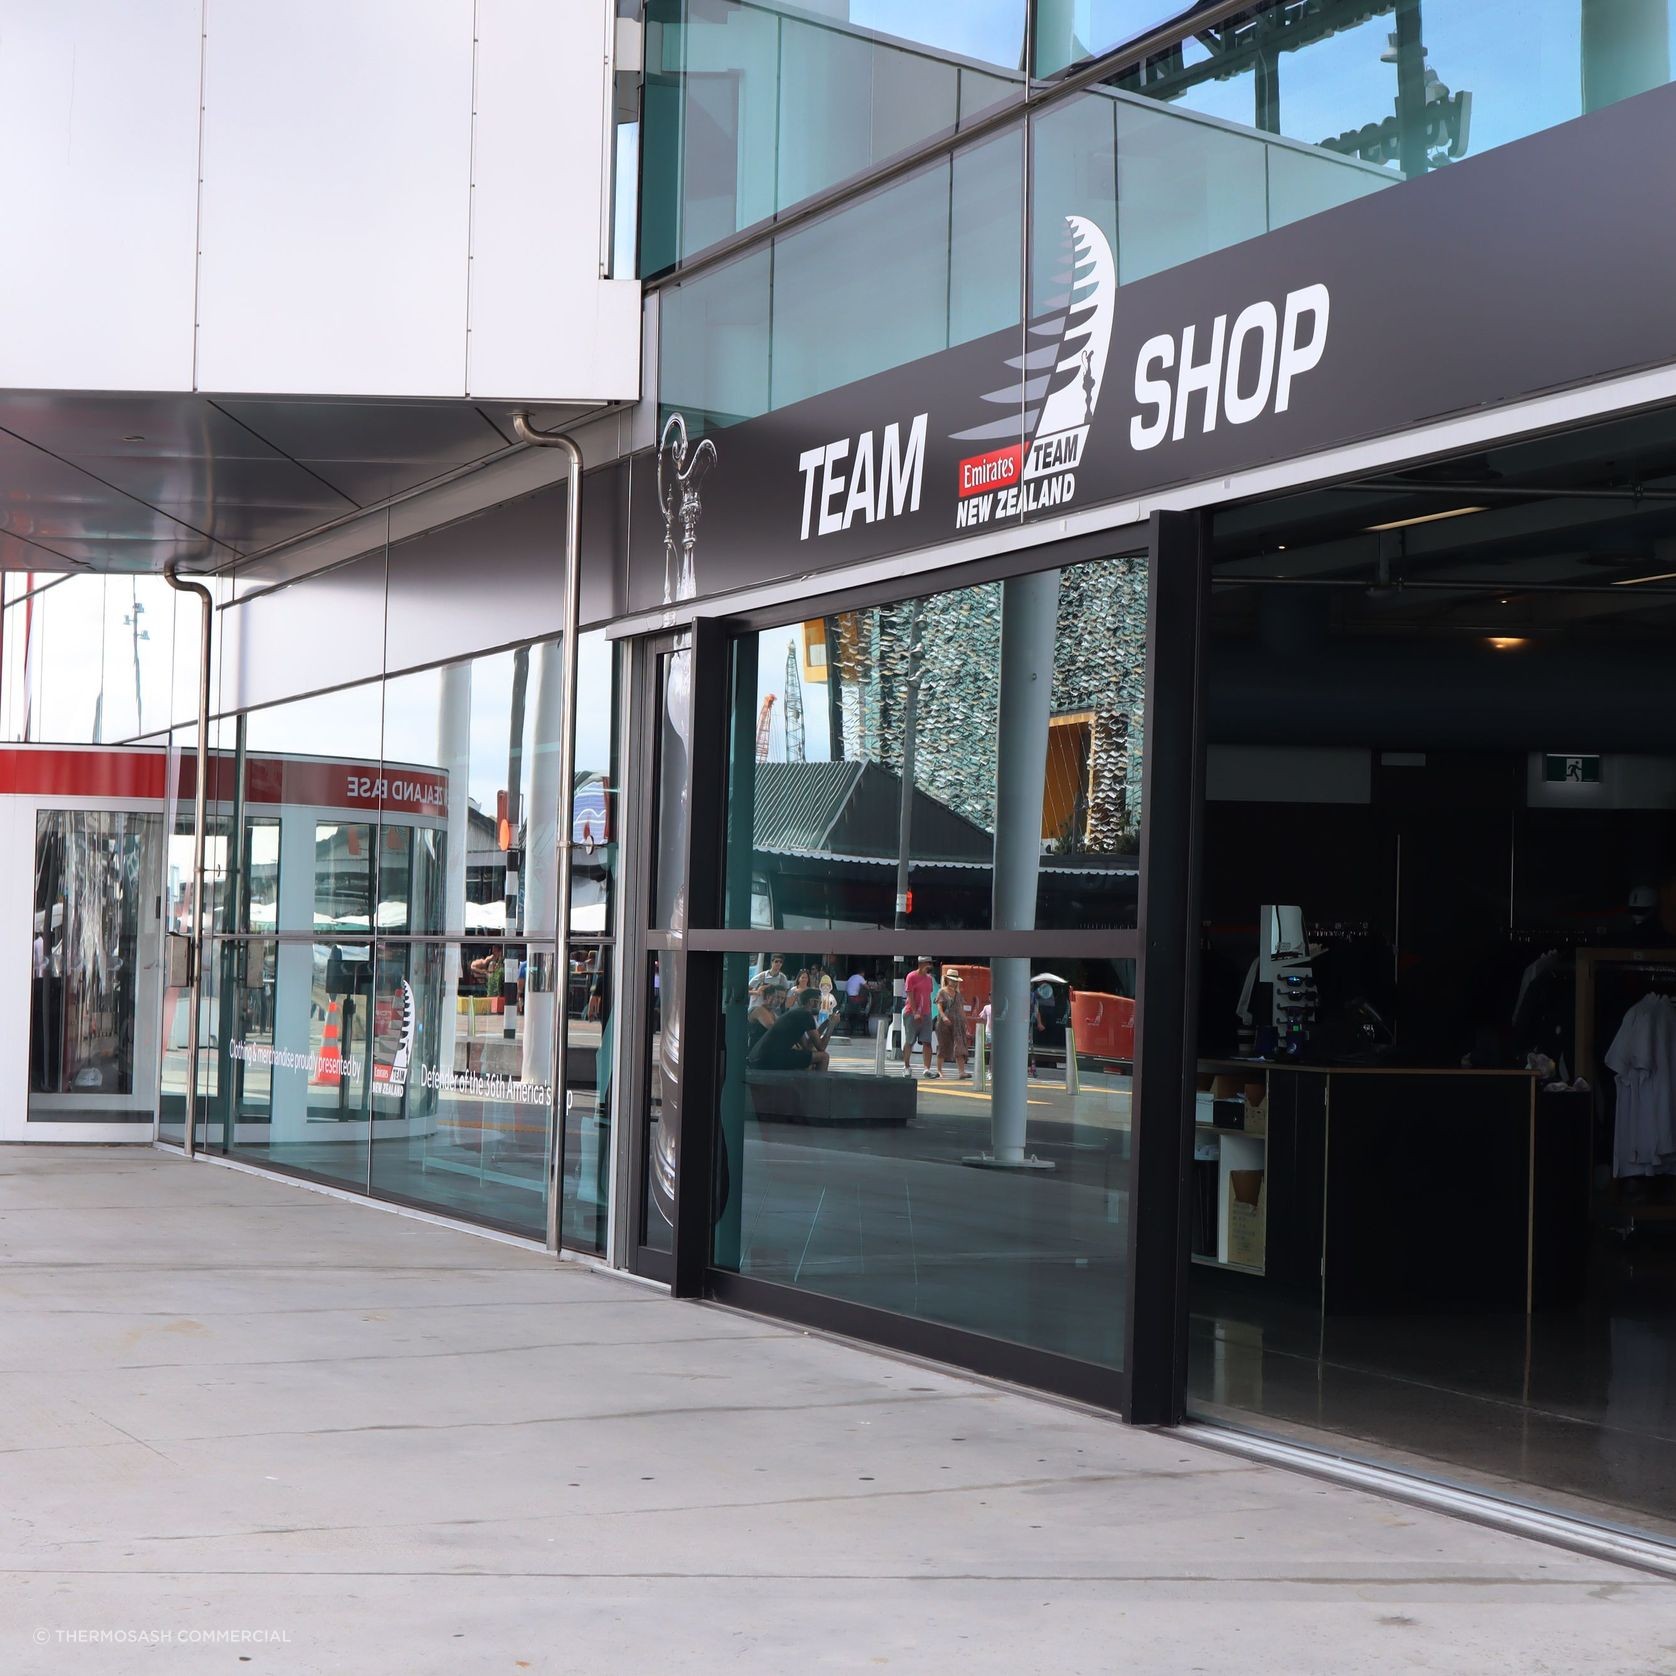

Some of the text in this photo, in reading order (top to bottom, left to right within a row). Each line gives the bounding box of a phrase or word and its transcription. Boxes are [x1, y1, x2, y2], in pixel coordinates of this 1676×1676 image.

[798, 283, 1330, 541] TEAM SHOP
[963, 456, 1014, 489] Emirates
[1033, 433, 1079, 472] TEAM
[956, 472, 1076, 529] NEW ZEALAND
[229, 1038, 361, 1083] Clothing & merchandise proudly presented by
[393, 1067, 405, 1081] TEAM
[373, 1081, 404, 1098] NEW ZEALAND
[421, 1063, 458, 1092] Defender
[459, 1068, 469, 1094] of
[469, 1070, 483, 1096] the
[485, 1073, 505, 1099] 36th
[506, 1075, 552, 1106] America's
